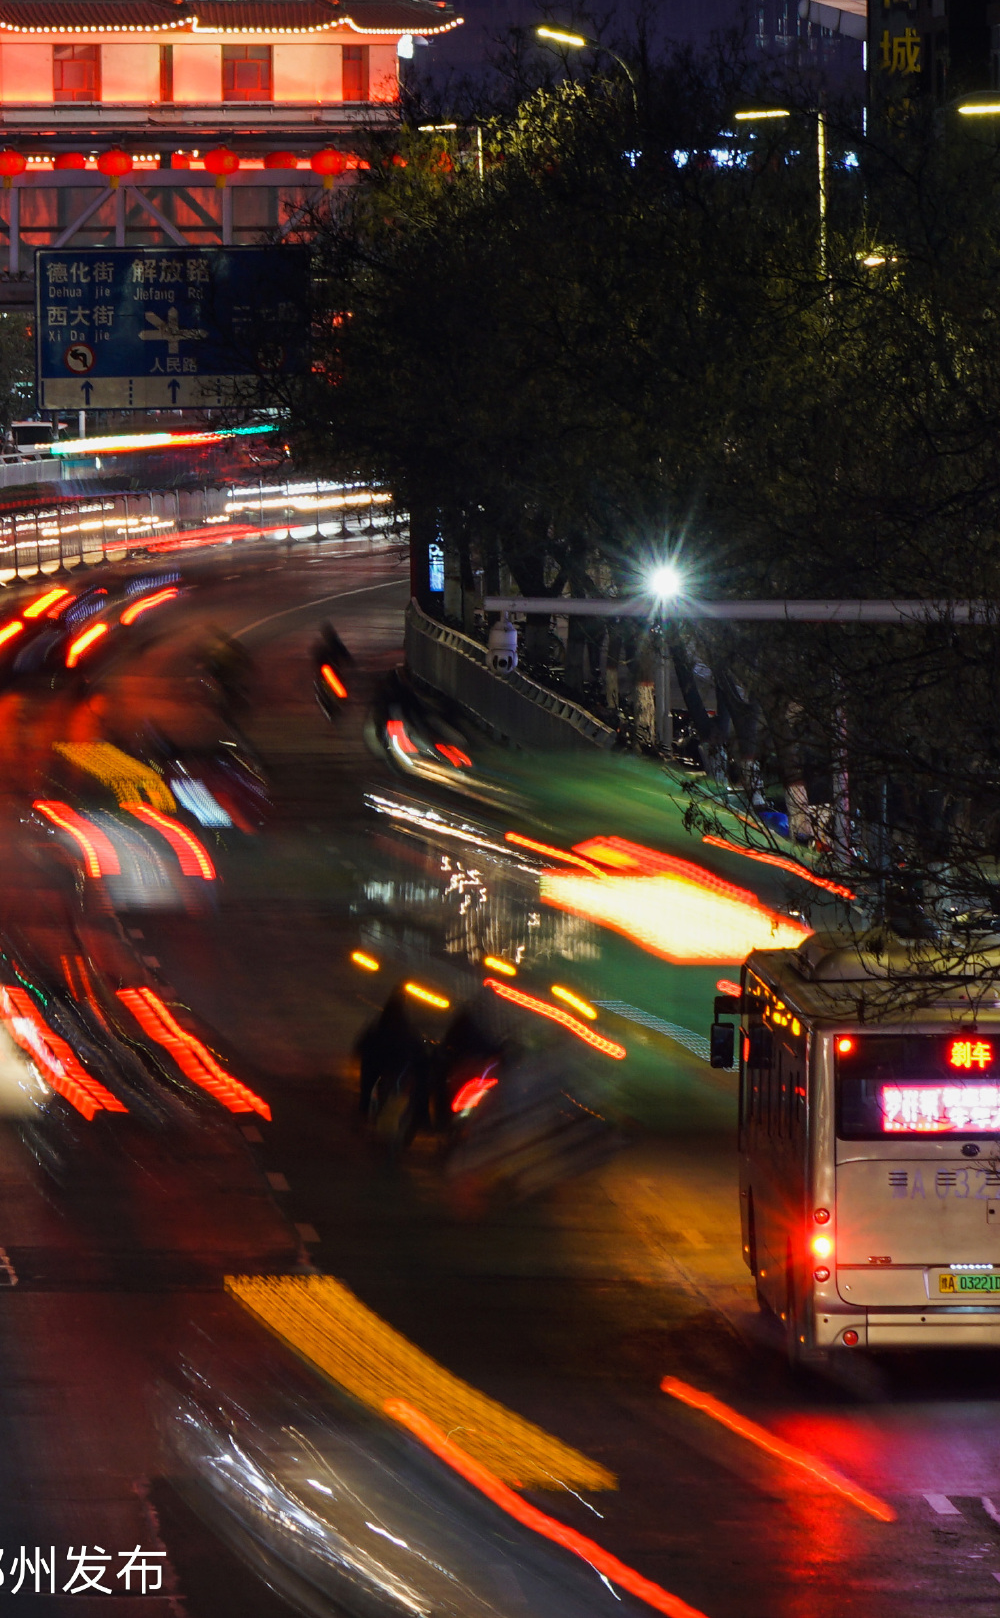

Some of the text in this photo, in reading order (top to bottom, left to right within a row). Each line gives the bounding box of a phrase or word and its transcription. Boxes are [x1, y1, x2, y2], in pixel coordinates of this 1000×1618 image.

[46, 258, 210, 283] 德化街 解放路
[49, 286, 82, 298] Dehua
[133, 287, 175, 303] Jiefang
[46, 306, 114, 326] 西大街
[49, 331, 61, 342] Xi
[70, 331, 85, 342] Da
[150, 357, 197, 373] 人民路
